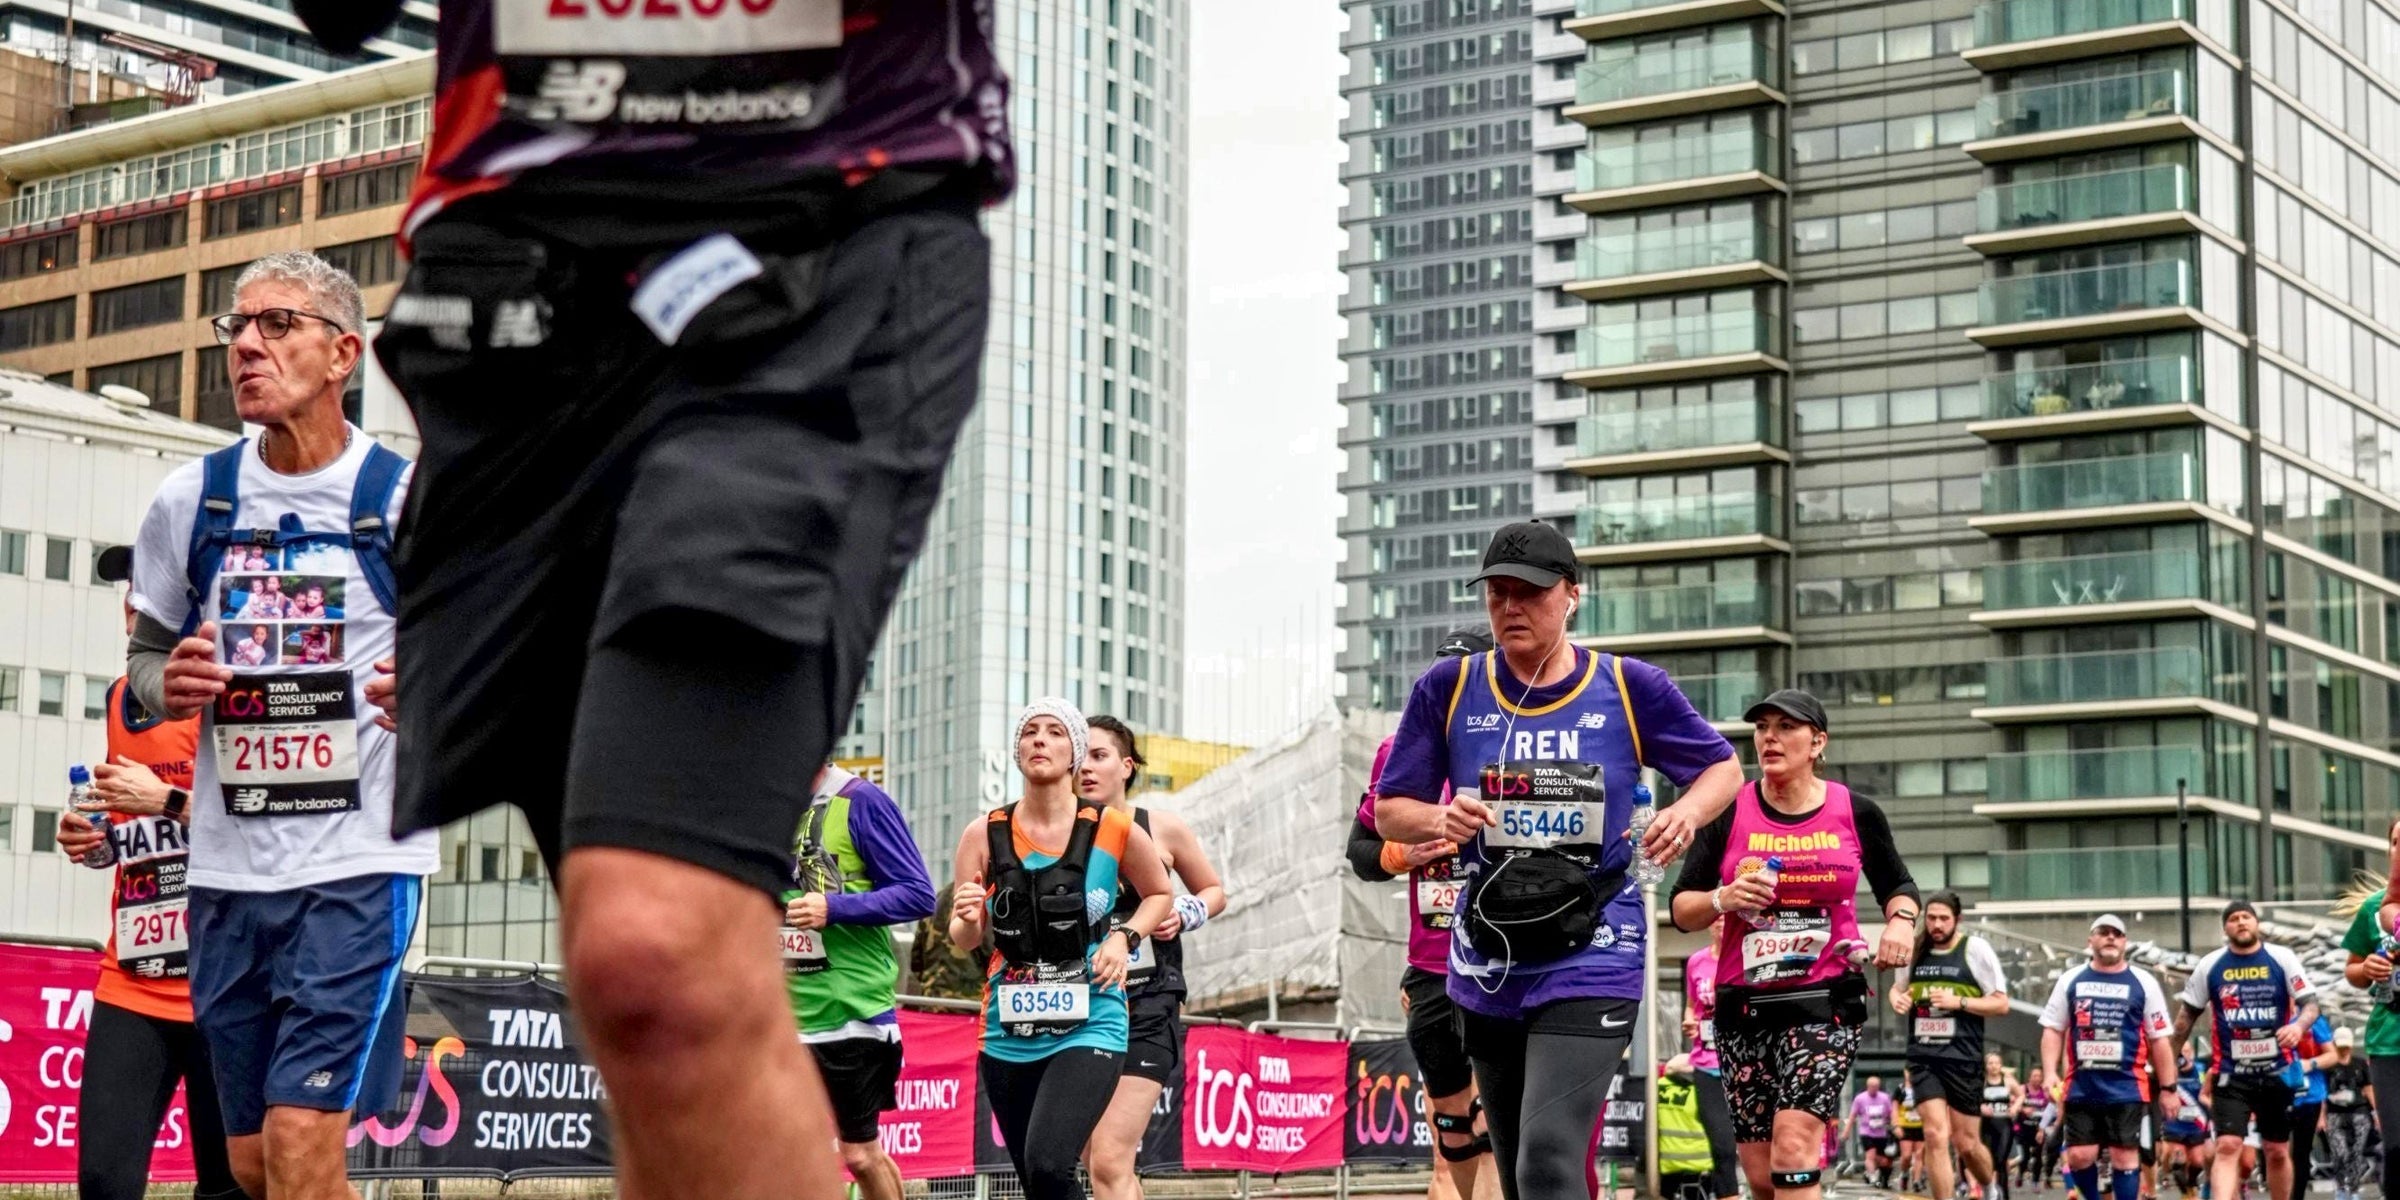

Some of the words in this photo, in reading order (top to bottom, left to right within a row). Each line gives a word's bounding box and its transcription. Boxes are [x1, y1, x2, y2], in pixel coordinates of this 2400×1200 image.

[619, 96, 684, 123] new
[686, 89, 812, 124] balance
[268, 683, 300, 693] TATA
[268, 691, 344, 705] CONSULTANCY
[269, 705, 317, 716] SERVICES
[234, 733, 333, 771] 21576
[1514, 730, 1579, 760] REN
[1487, 769, 1529, 795] tcs
[1534, 768, 1561, 776] TATA
[1533, 787, 1574, 796] SERVICES
[1534, 777, 1596, 787] CONSULTANCY
[269, 802, 293, 811] new
[295, 798, 348, 811] balance
[1503, 809, 1584, 838] 55446
[1748, 831, 1841, 853] Michelle
[158, 862, 186, 873] TATA
[1779, 871, 1838, 883] Research
[1814, 862, 1854, 872] Tumour
[778, 934, 813, 953] 9429
[167, 966, 188, 976] new
[1038, 970, 1083, 978] CONSULTANCY
[2223, 966, 2270, 981] GUIDE
[1012, 991, 1074, 1013] 63549
[2223, 1006, 2278, 1021] WAYNE
[489, 1009, 564, 1049] TATA
[480, 1059, 608, 1101] CONSULTA
[1194, 1049, 1254, 1148] tcs
[1258, 1055, 1292, 1084] TATA
[1256, 1090, 1334, 1118] CONSULTANCY
[1356, 1060, 1410, 1145] tcs
[474, 1110, 592, 1150] SERVICES
[1256, 1125, 1307, 1153] SERVICES
